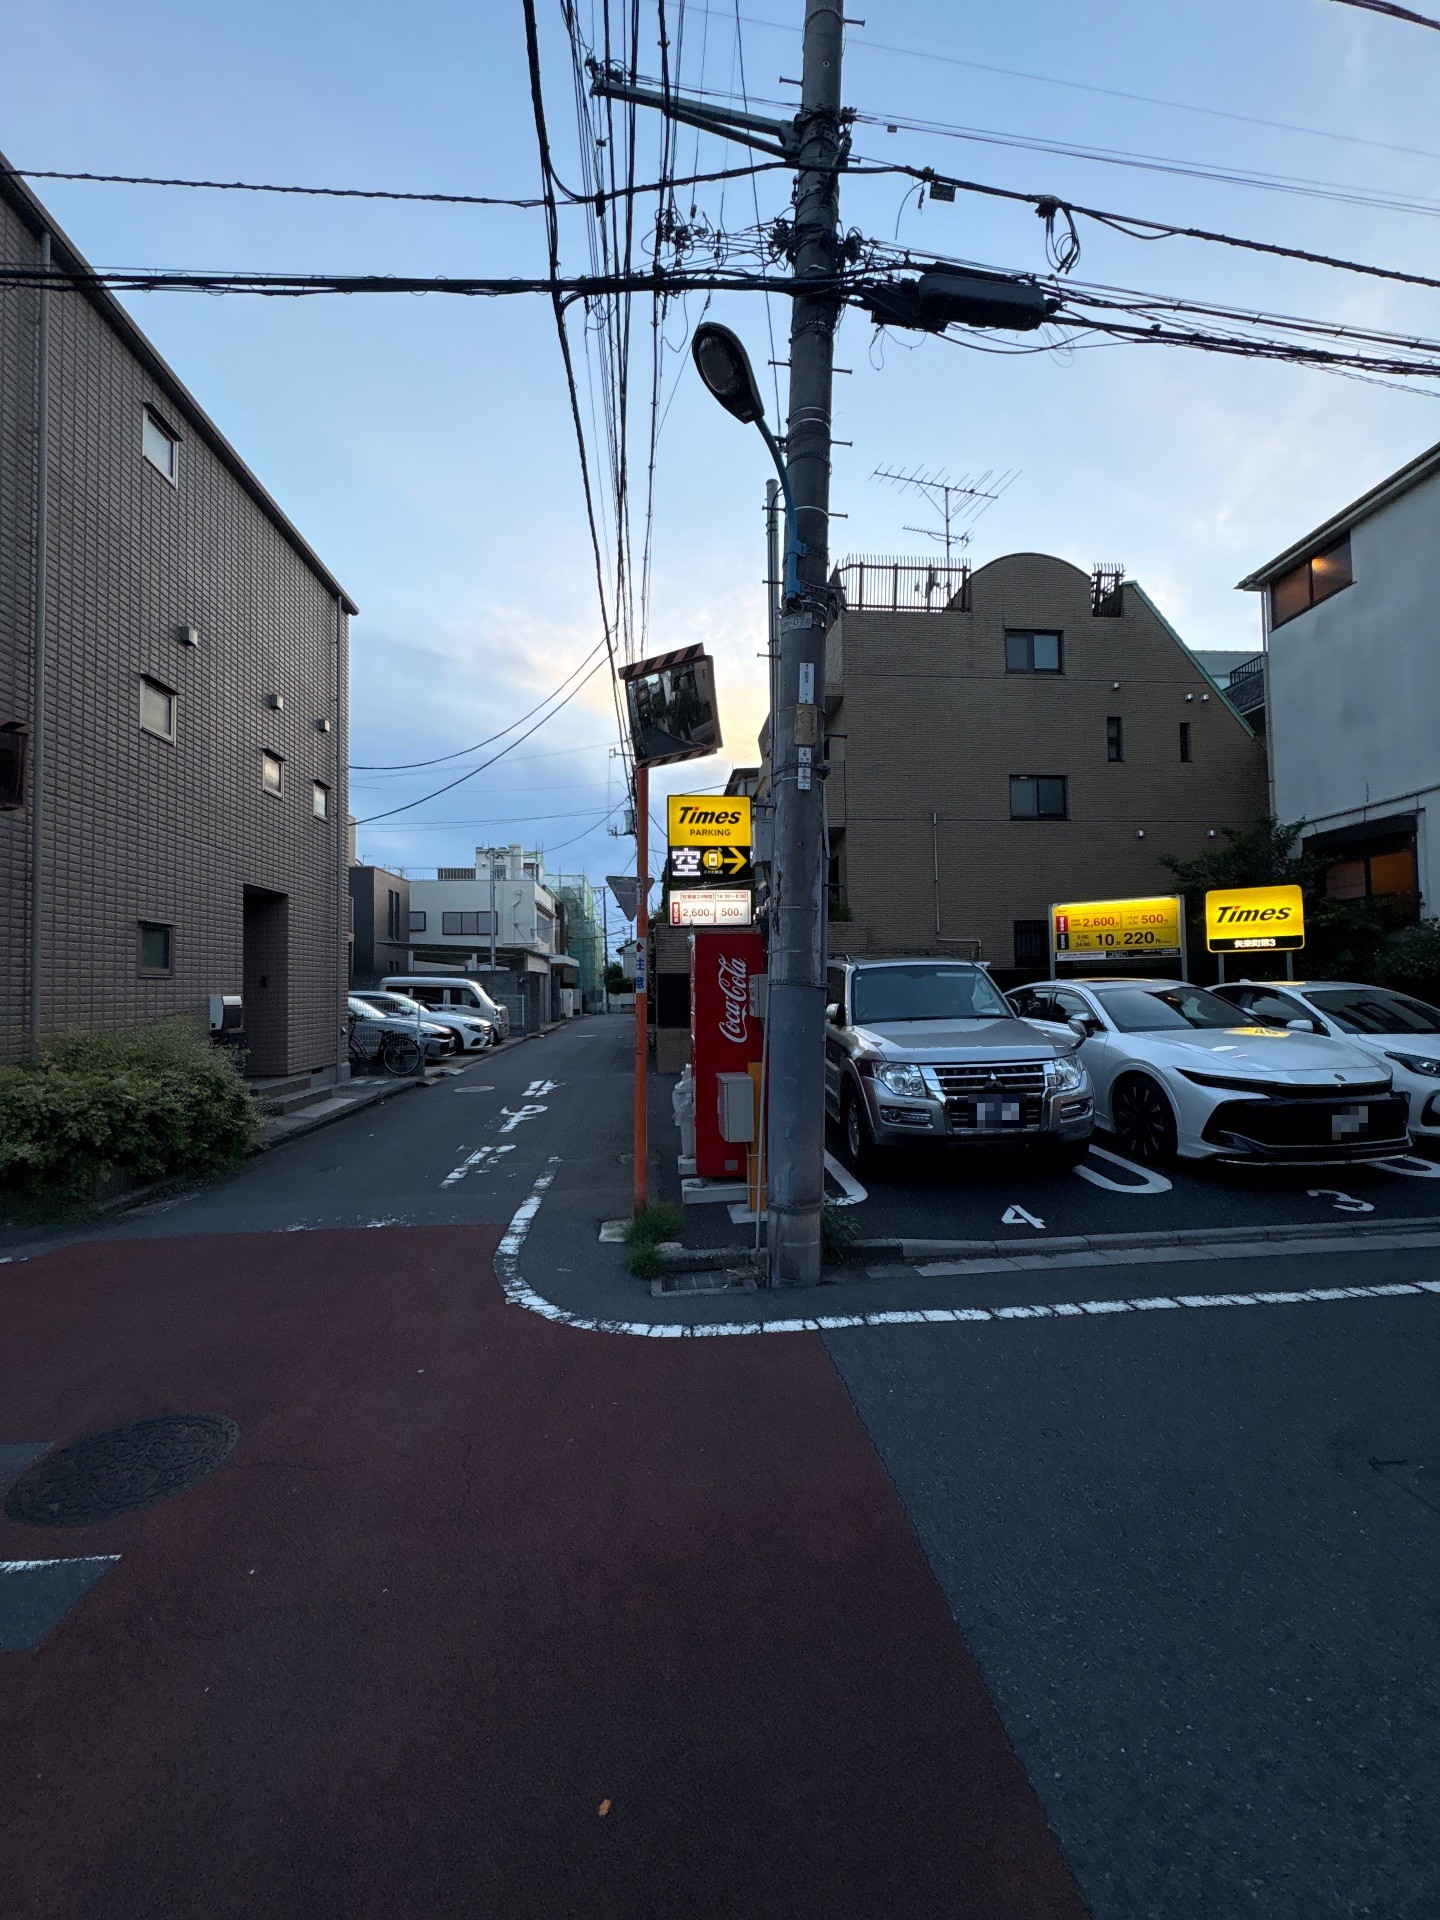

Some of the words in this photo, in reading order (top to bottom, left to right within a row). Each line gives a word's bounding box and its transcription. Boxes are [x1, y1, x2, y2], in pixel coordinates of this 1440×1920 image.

[678, 806, 742, 825] Times
[689, 828, 731, 837] PARKING
[671, 847, 701, 876] 空
[1216, 905, 1293, 923] Times
[717, 952, 748, 1043] Coca-Cola
[1307, 1189, 1375, 1213] 3
[1000, 1204, 1047, 1230] 4
